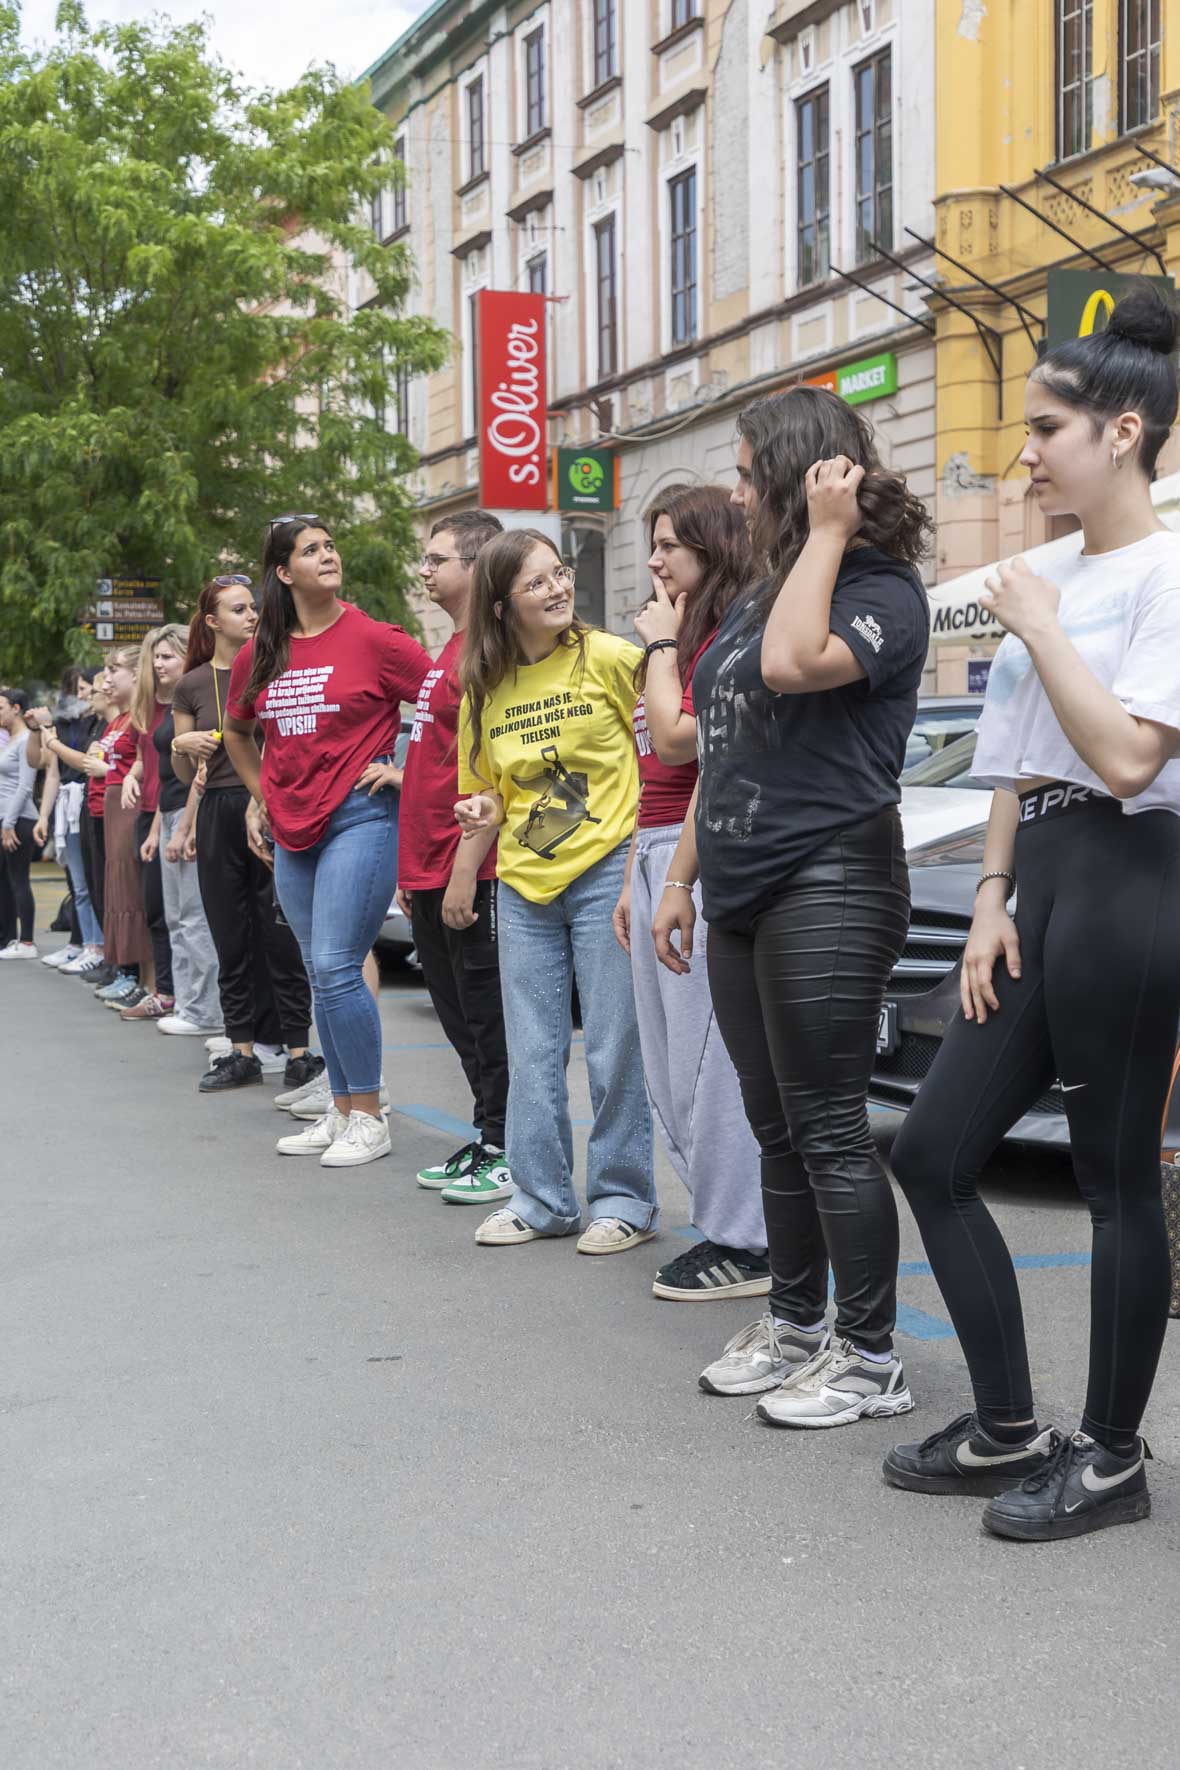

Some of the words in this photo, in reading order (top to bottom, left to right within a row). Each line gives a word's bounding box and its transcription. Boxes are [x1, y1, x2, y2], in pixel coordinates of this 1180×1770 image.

[841, 365, 886, 397] MARKET
[487, 318, 541, 485] s.Oliver
[851, 615, 884, 653] LONSDALE
[505, 700, 542, 719] STRUKA
[543, 695, 561, 710] NAS
[562, 692, 573, 704] JE
[277, 715, 317, 737] UPIS!!!
[489, 716, 543, 740] OBLIKOVALA
[544, 708, 565, 723] VIŠE
[567, 703, 593, 718] NEGO
[520, 726, 561, 745] TJELESNI
[1040, 784, 1109, 815] PR
